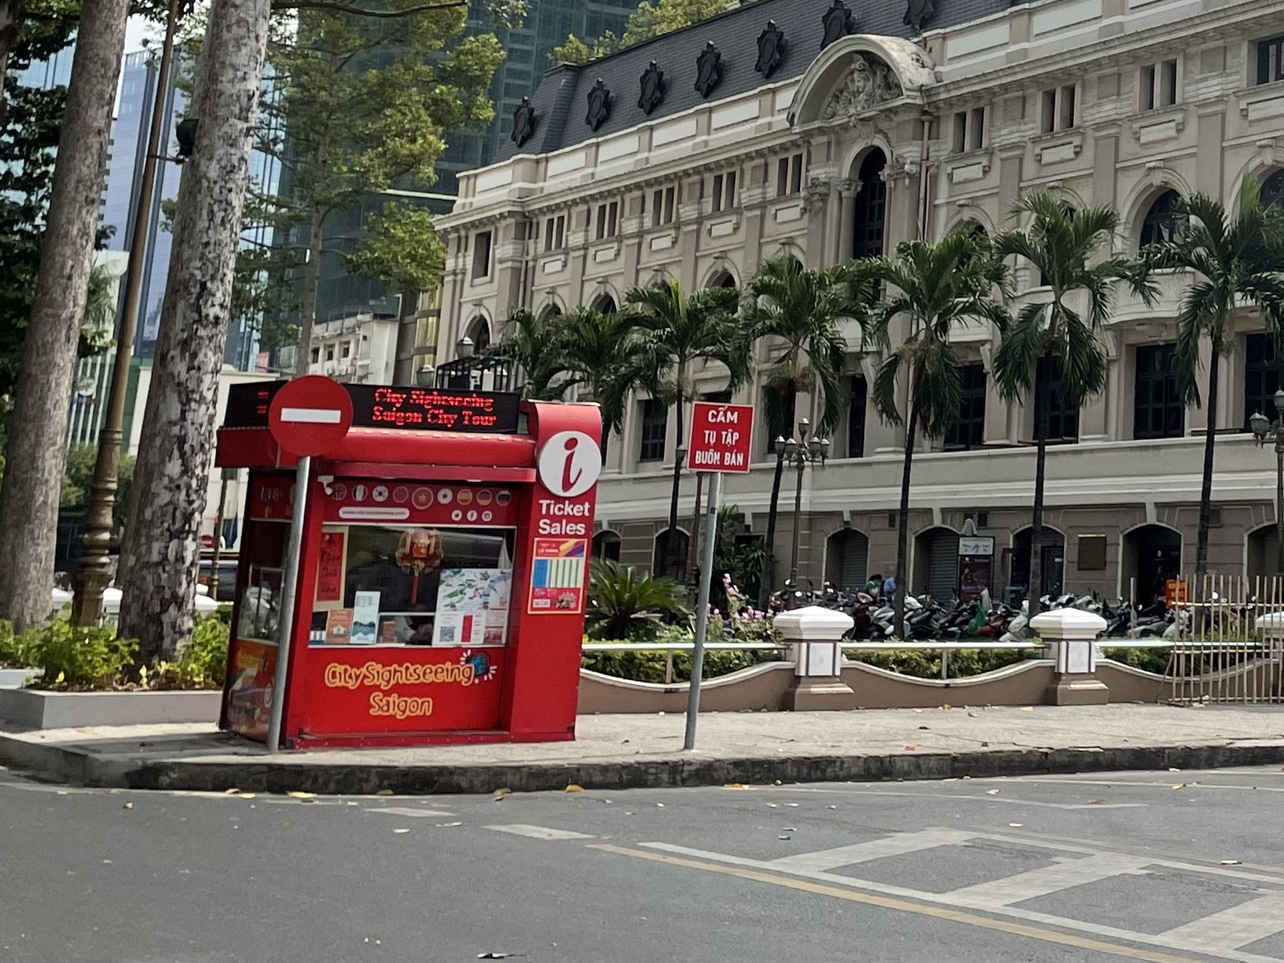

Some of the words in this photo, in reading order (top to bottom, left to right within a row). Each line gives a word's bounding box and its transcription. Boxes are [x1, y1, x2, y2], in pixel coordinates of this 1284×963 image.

[375, 388, 407, 408] City
[372, 405, 422, 426] Saigon
[427, 409, 458, 428] City
[462, 410, 497, 426] Tour
[708, 405, 738, 424] CẤM
[704, 429, 717, 446] TỤ
[721, 428, 739, 447] TẬP
[695, 448, 720, 465] BUÔN
[724, 449, 744, 466] BÁN
[538, 499, 590, 517] Ticket
[538, 518, 586, 535] Sales
[369, 692, 433, 720] Saigon
